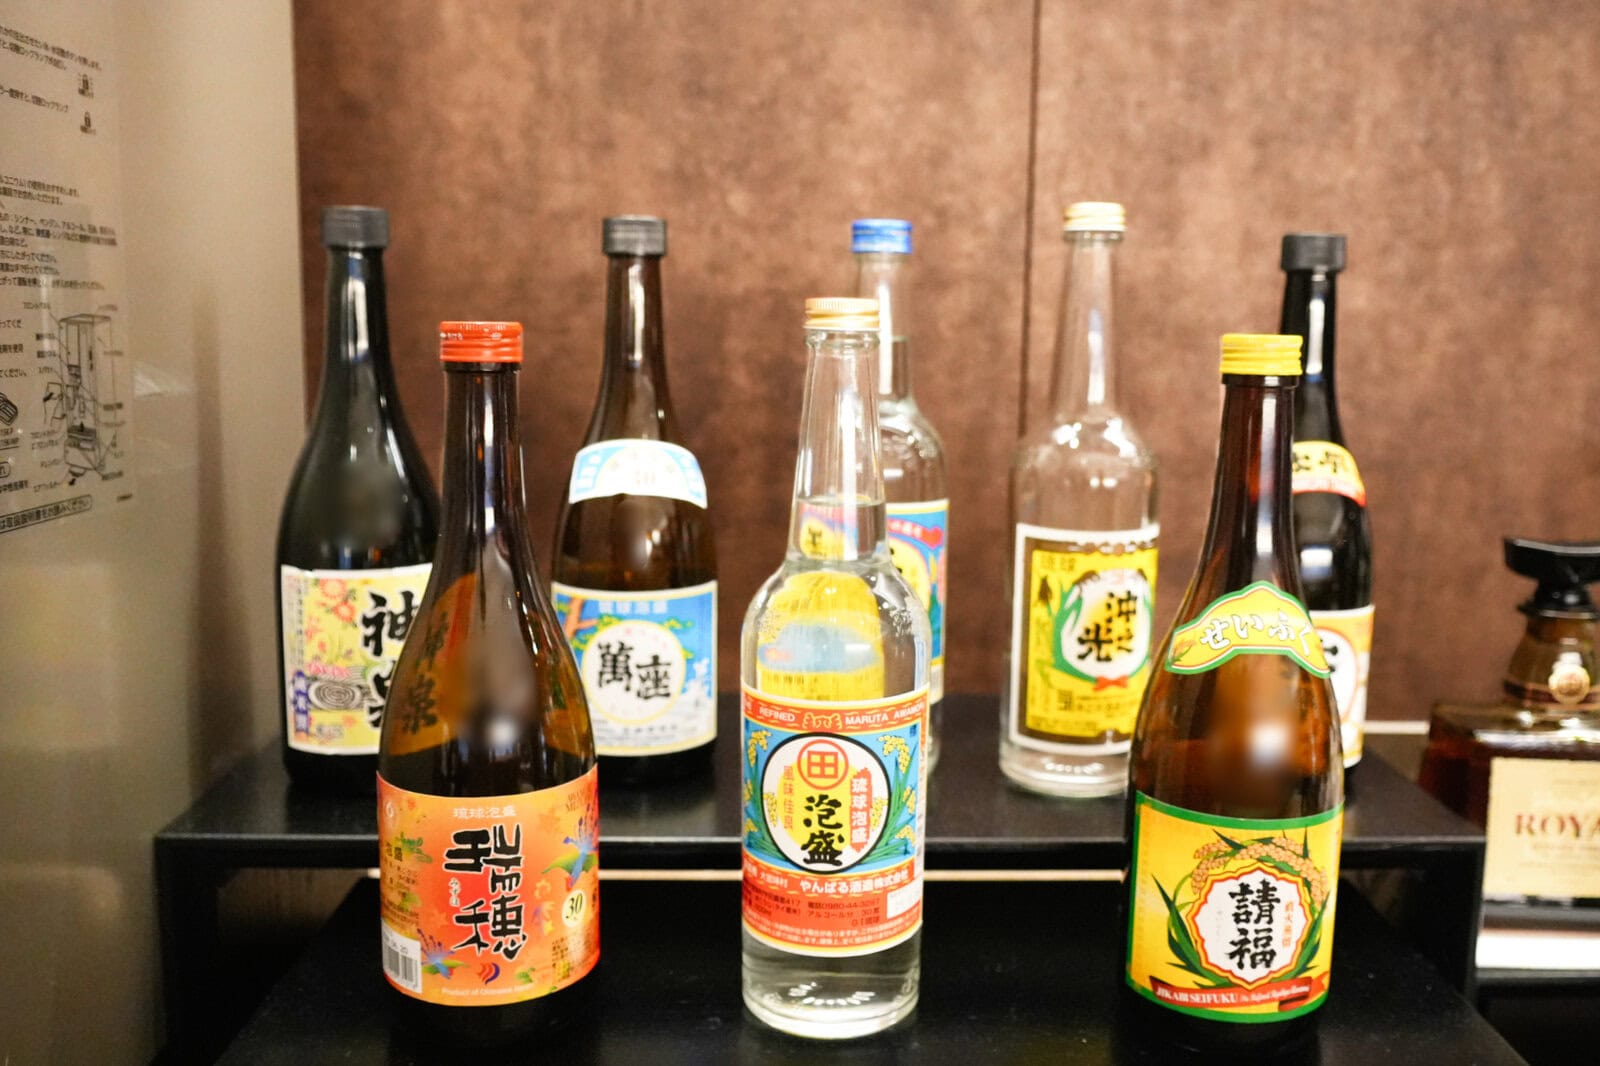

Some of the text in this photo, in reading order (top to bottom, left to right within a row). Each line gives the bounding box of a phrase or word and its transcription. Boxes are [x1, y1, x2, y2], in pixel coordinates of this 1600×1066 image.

[1200, 608, 1311, 657] せいふく
[597, 641, 672, 700] 萬座
[759, 706, 796, 723] REFINED
[845, 712, 889, 725] MARUTA
[800, 793, 845, 867] 泡盛
[851, 777, 868, 843] 琉球泡盛
[1228, 877, 1281, 971] 請福
[1188, 989, 1239, 1004] SEIFUKU
